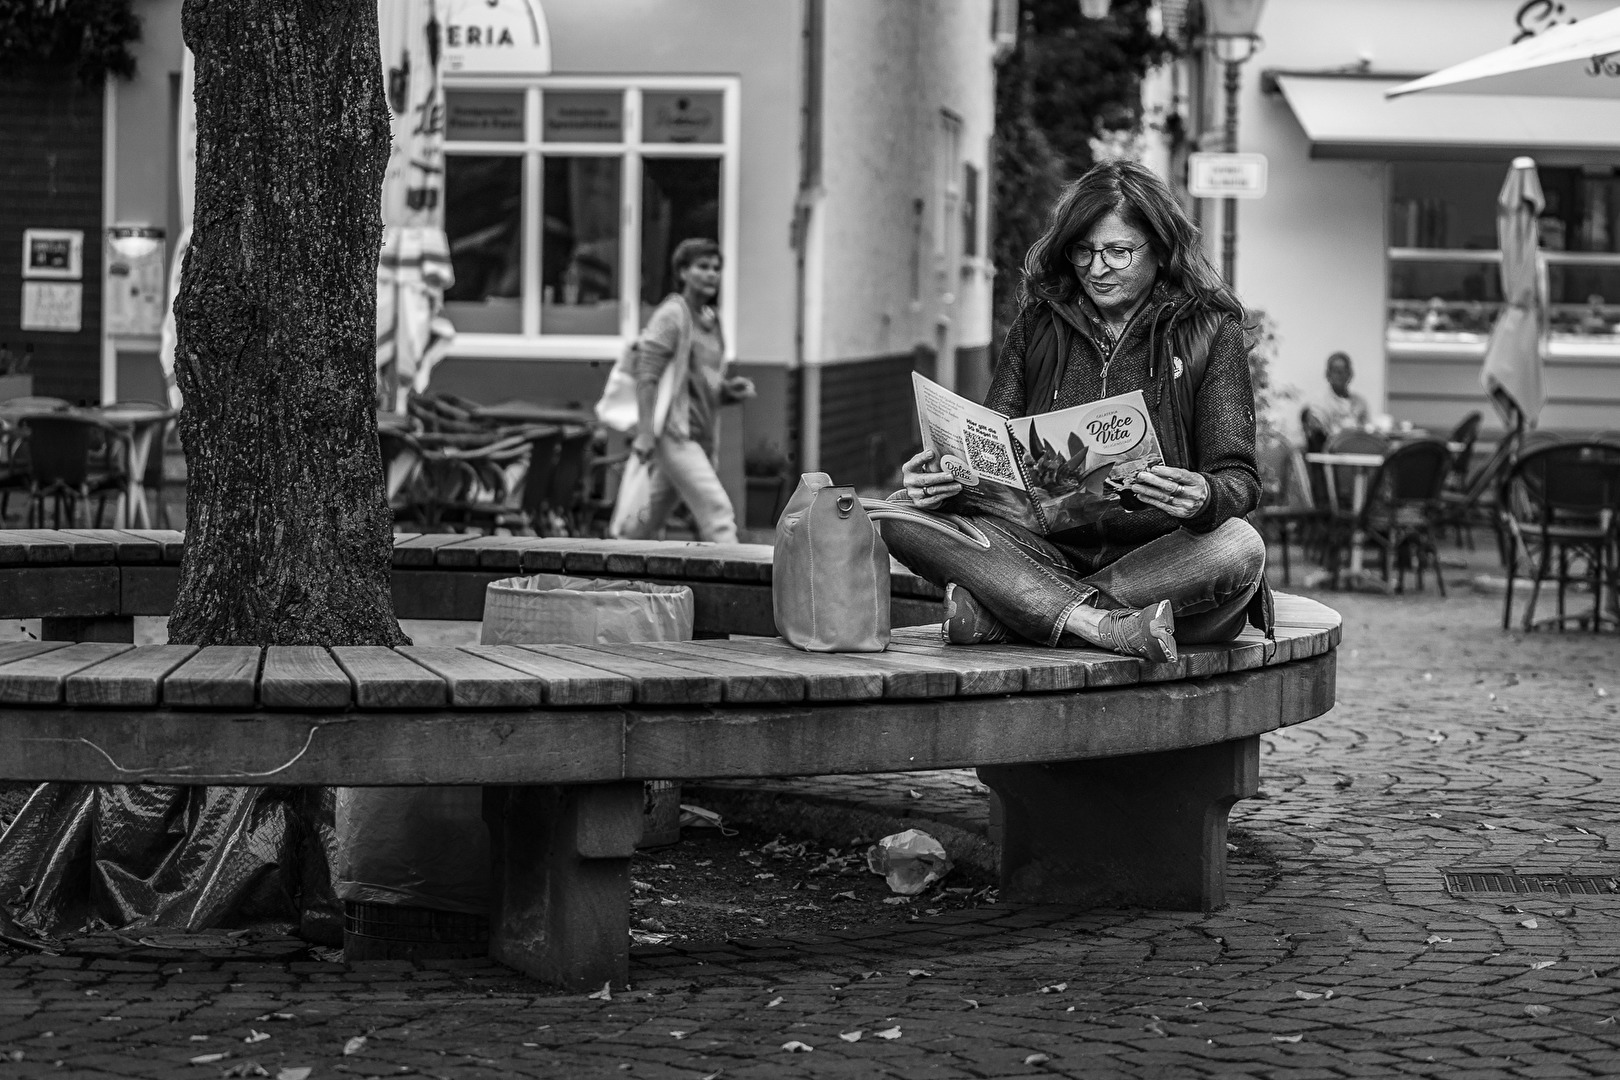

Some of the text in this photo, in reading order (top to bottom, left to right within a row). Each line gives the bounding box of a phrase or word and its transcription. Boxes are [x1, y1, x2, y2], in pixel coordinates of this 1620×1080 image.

[1086, 415, 1133, 435] Dolce
[1096, 428, 1131, 444] Vita
[945, 461, 972, 475] Dolce
